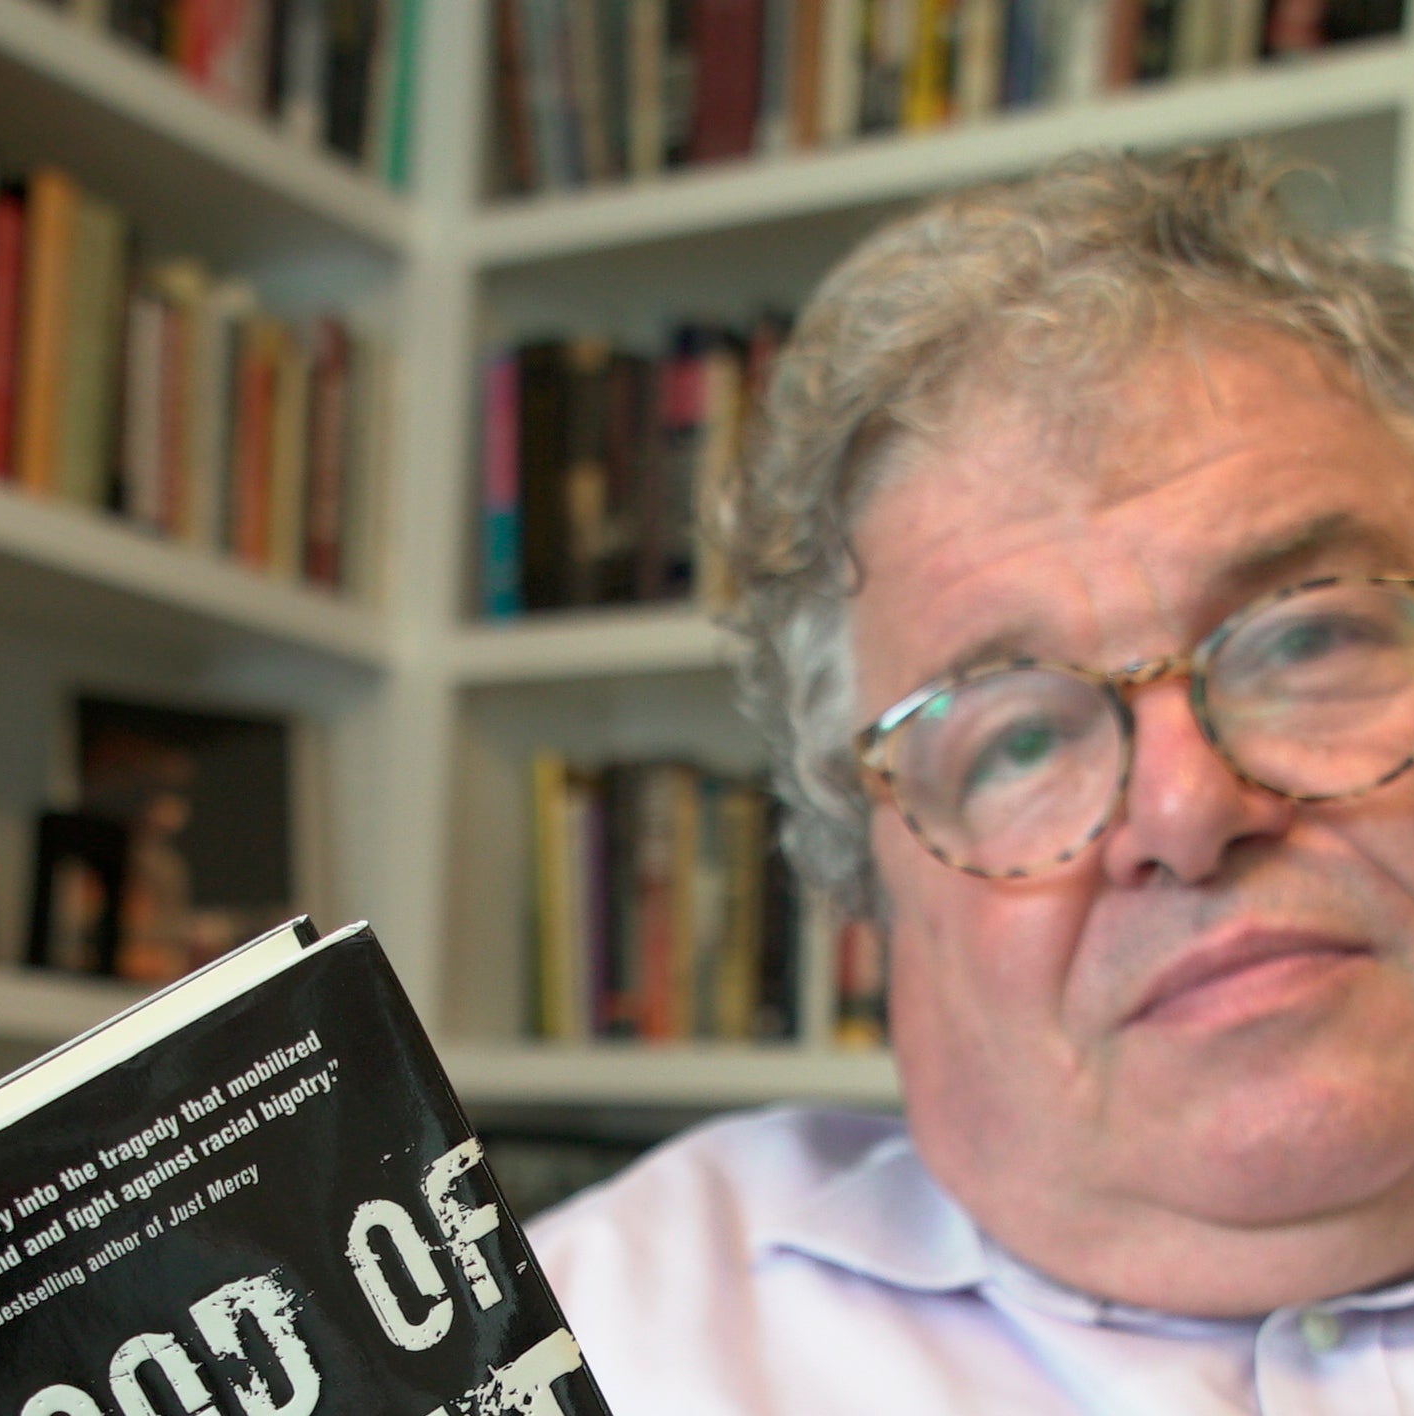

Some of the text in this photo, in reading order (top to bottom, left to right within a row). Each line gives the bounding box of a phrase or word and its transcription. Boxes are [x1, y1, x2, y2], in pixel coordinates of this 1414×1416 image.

[13, 1184, 60, 1217] into
[59, 1163, 98, 1191] the
[98, 1115, 180, 1169] tragedy
[179, 1086, 226, 1123] that
[226, 1029, 322, 1098] mobilized
[23, 1219, 66, 1256] and
[66, 1190, 119, 1231] fight
[120, 1144, 198, 1202] against
[199, 1109, 259, 1156] racial
[87, 1232, 141, 1272] author
[145, 1215, 164, 1238] of
[169, 1192, 206, 1227] Just
[206, 1164, 259, 1204] Mercy
[344, 1137, 502, 1351] OF
